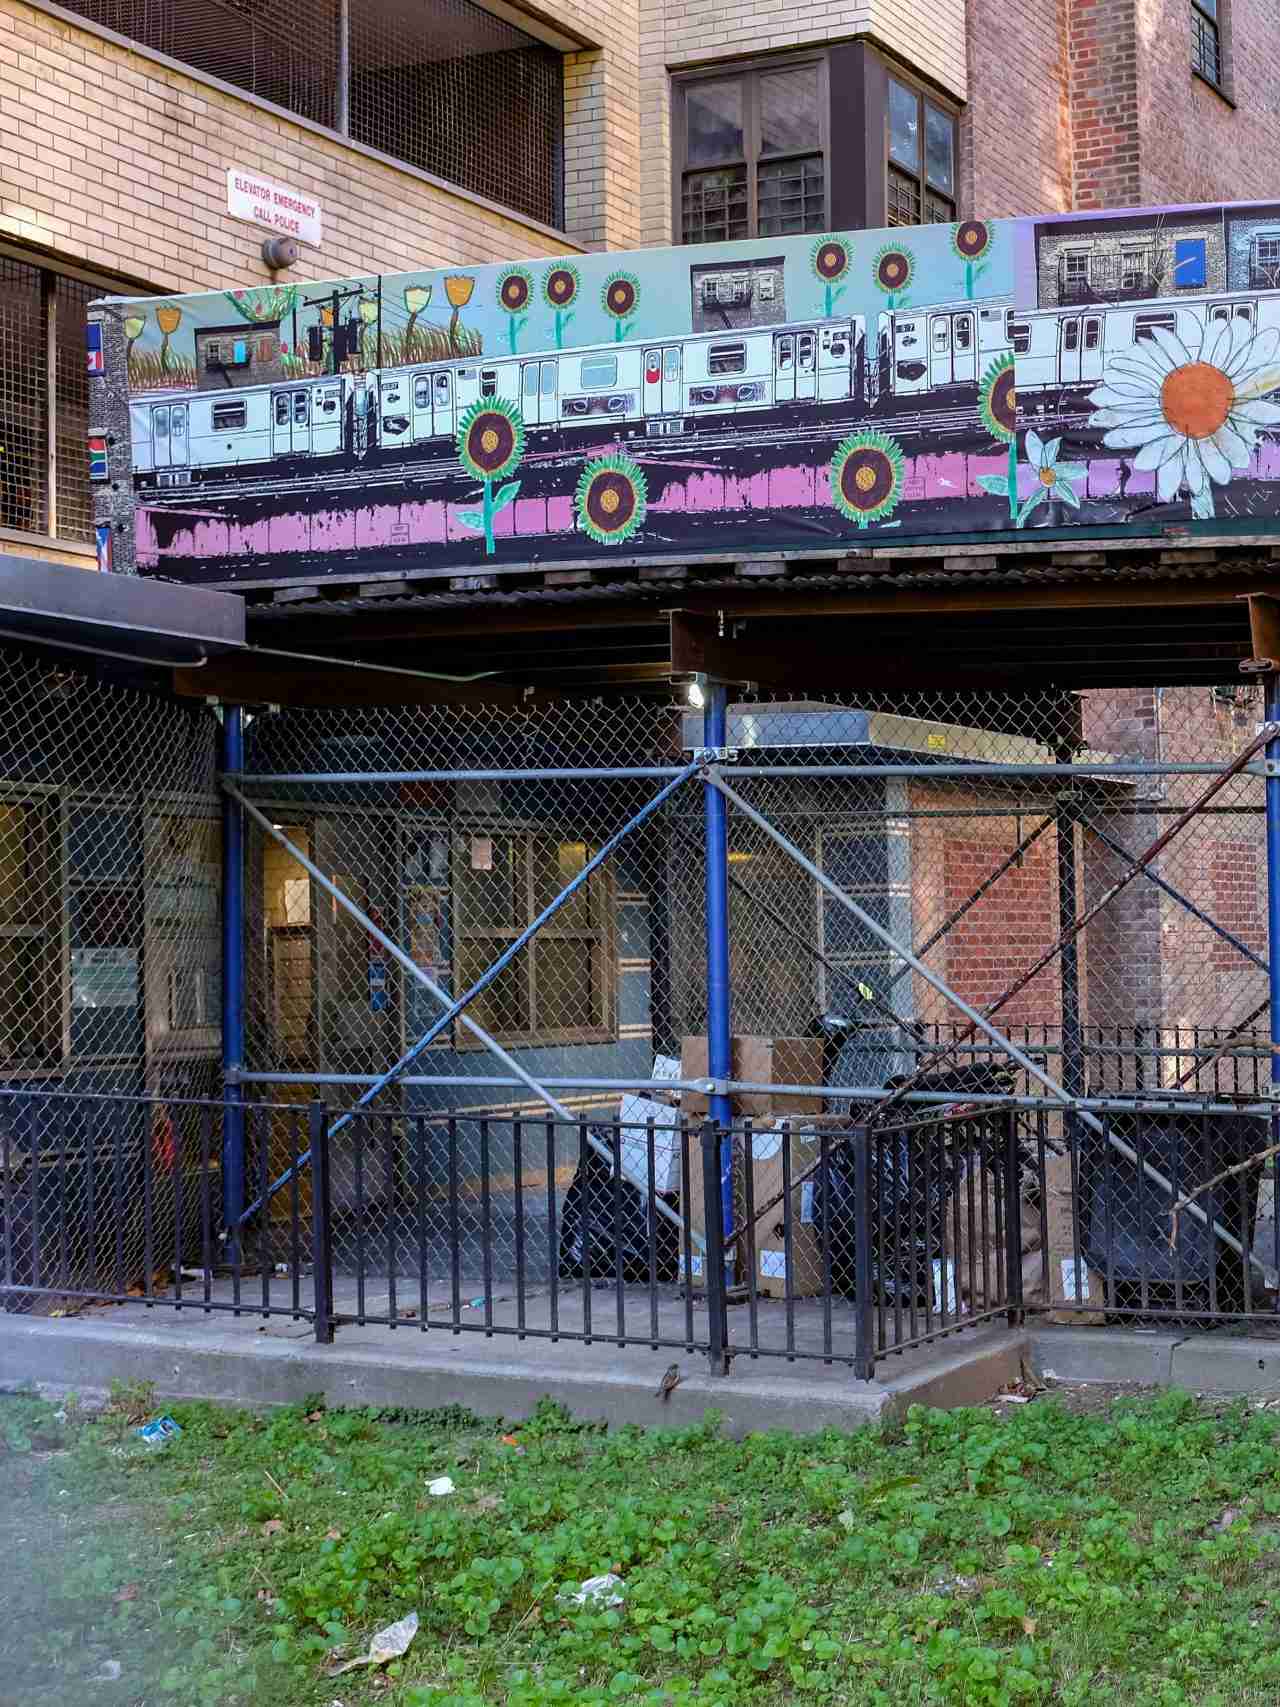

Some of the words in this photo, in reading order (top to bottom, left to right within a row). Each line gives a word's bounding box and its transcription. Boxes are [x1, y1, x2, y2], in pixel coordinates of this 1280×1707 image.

[234, 177, 271, 201] ELEVATOR
[273, 192, 316, 218] EMERGENCY
[253, 205, 272, 224] CALL
[274, 213, 300, 234] POLICE
